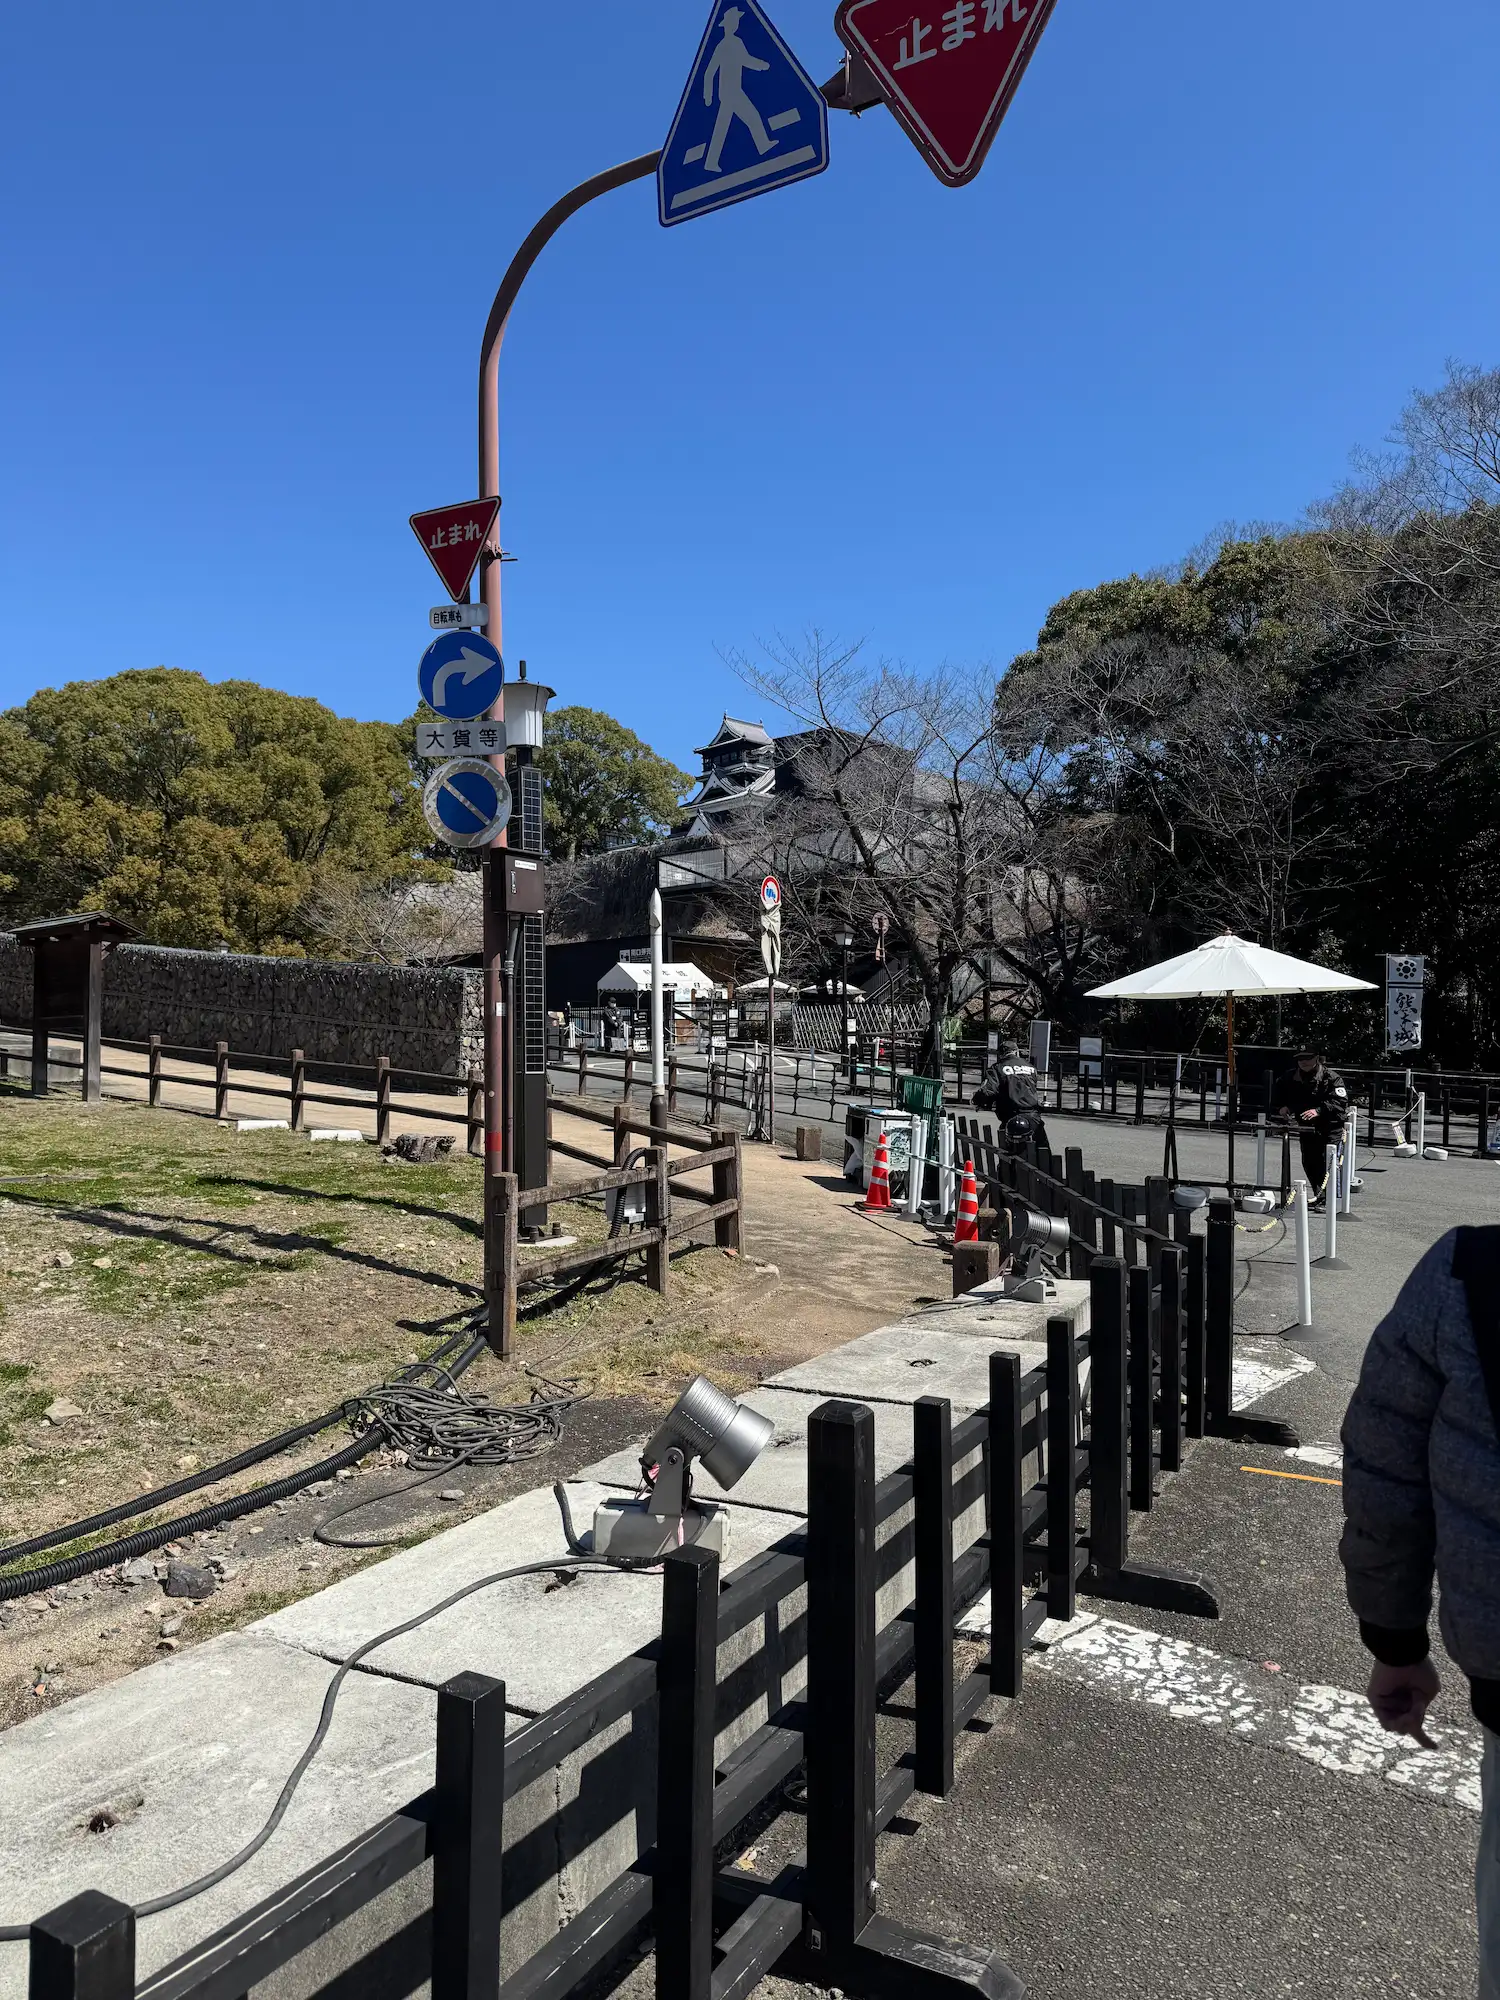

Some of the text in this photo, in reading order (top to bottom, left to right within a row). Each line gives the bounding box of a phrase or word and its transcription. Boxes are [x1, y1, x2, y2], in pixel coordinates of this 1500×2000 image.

[893, 0, 1028, 71] 止まれ
[430, 520, 482, 549] 止まれ
[433, 610, 462, 624] 自転車も
[426, 728, 498, 749] 大貨等
